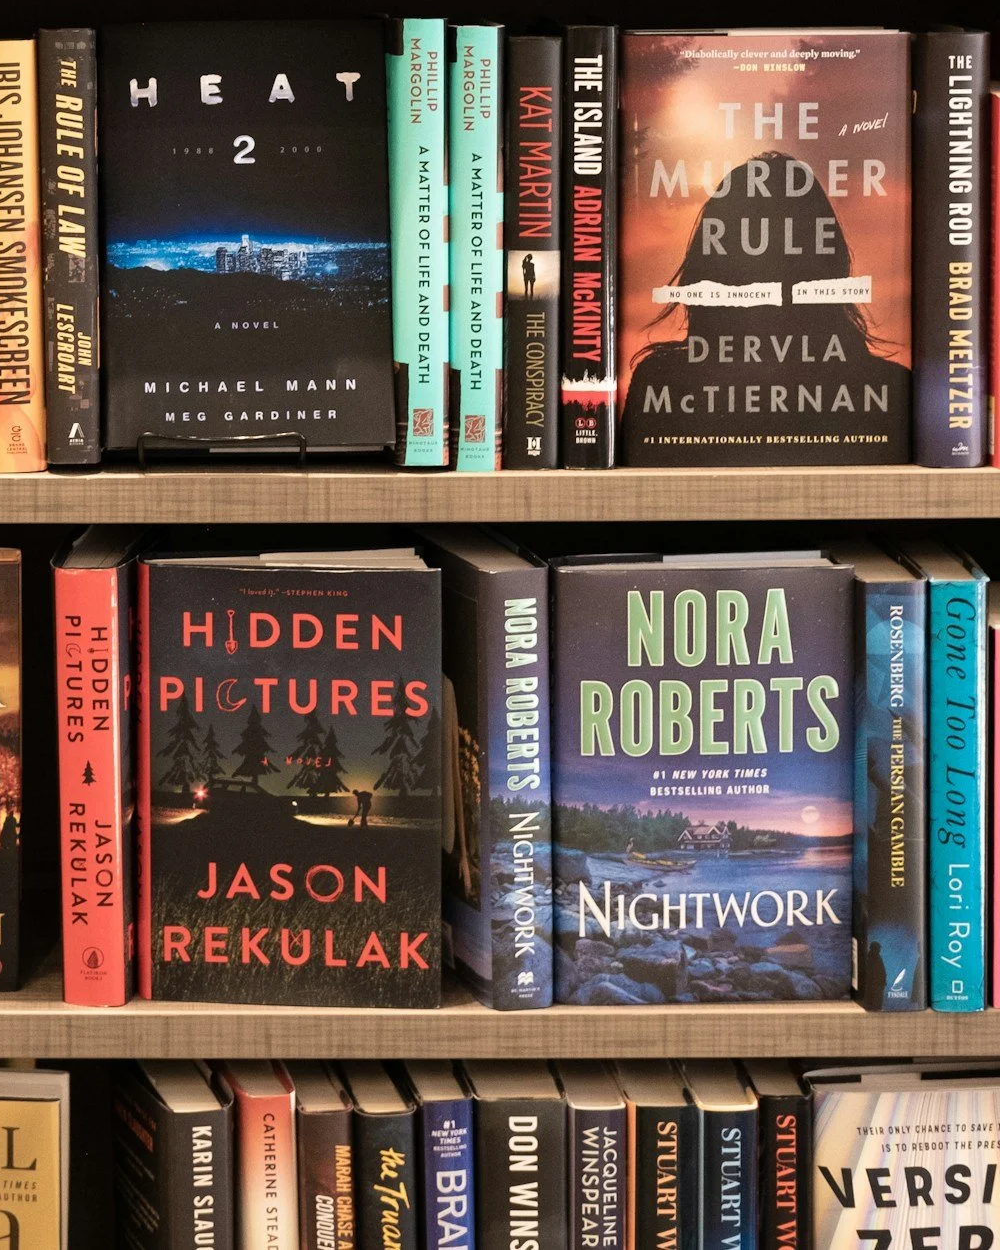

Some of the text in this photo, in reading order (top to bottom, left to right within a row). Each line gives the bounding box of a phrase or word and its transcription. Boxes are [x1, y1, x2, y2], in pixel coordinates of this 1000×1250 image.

[129, 72, 361, 107] HEAT
[719, 102, 820, 140] THE
[518, 86, 553, 239] KAT MARTIN
[649, 159, 888, 198] MURDER
[701, 218, 837, 256] RULE
[688, 335, 845, 363] DERVLA
[144, 379, 358, 394] MICHAEL MANN
[643, 385, 889, 414] McTIERNAN
[626, 587, 794, 667] NORA
[580, 675, 840, 756] ROBERTS
[650, 784, 770, 797] BESTSELLING AUTHOR
[197, 859, 388, 905] JASON
[941, 864, 969, 969] Lori Roy
